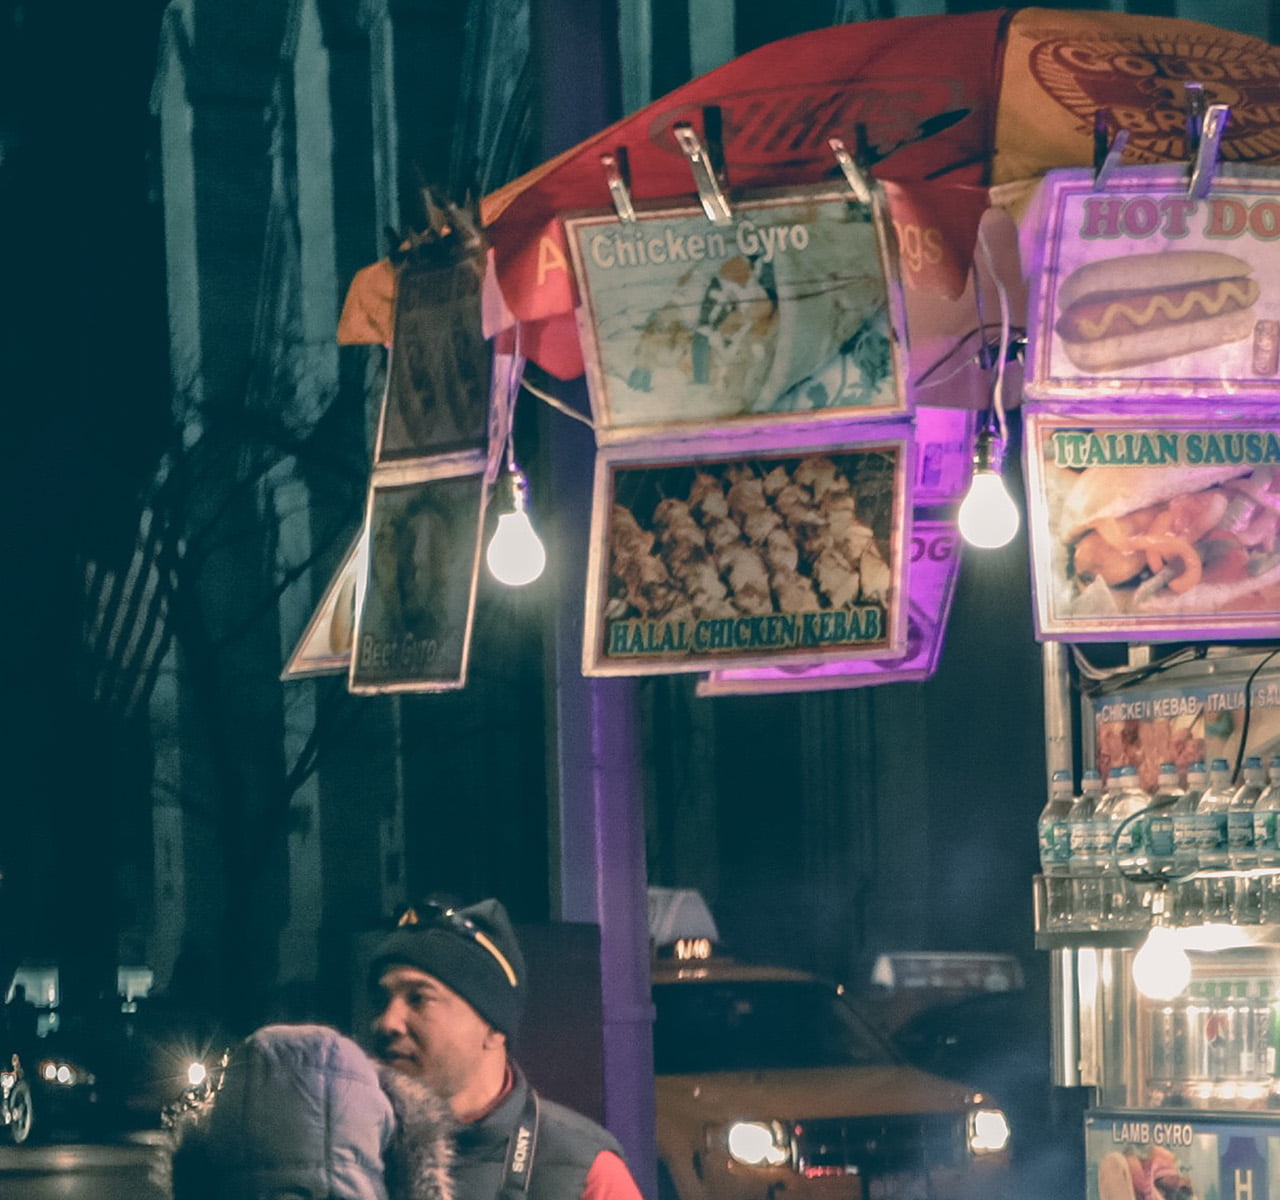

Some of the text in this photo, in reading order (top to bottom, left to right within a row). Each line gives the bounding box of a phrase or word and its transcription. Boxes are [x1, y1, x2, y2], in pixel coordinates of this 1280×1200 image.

[1081, 196, 1200, 241] HOT
[590, 219, 809, 269] Chicken Gyro
[1053, 430, 1180, 468] ITALIAN
[609, 608, 882, 656] HALAL CHICKEN KEBAB
[1101, 696, 1197, 723] CHICKEN KEBAB
[512, 1126, 530, 1173] SONY
[1111, 1122, 1193, 1146] LAMB GYRO
